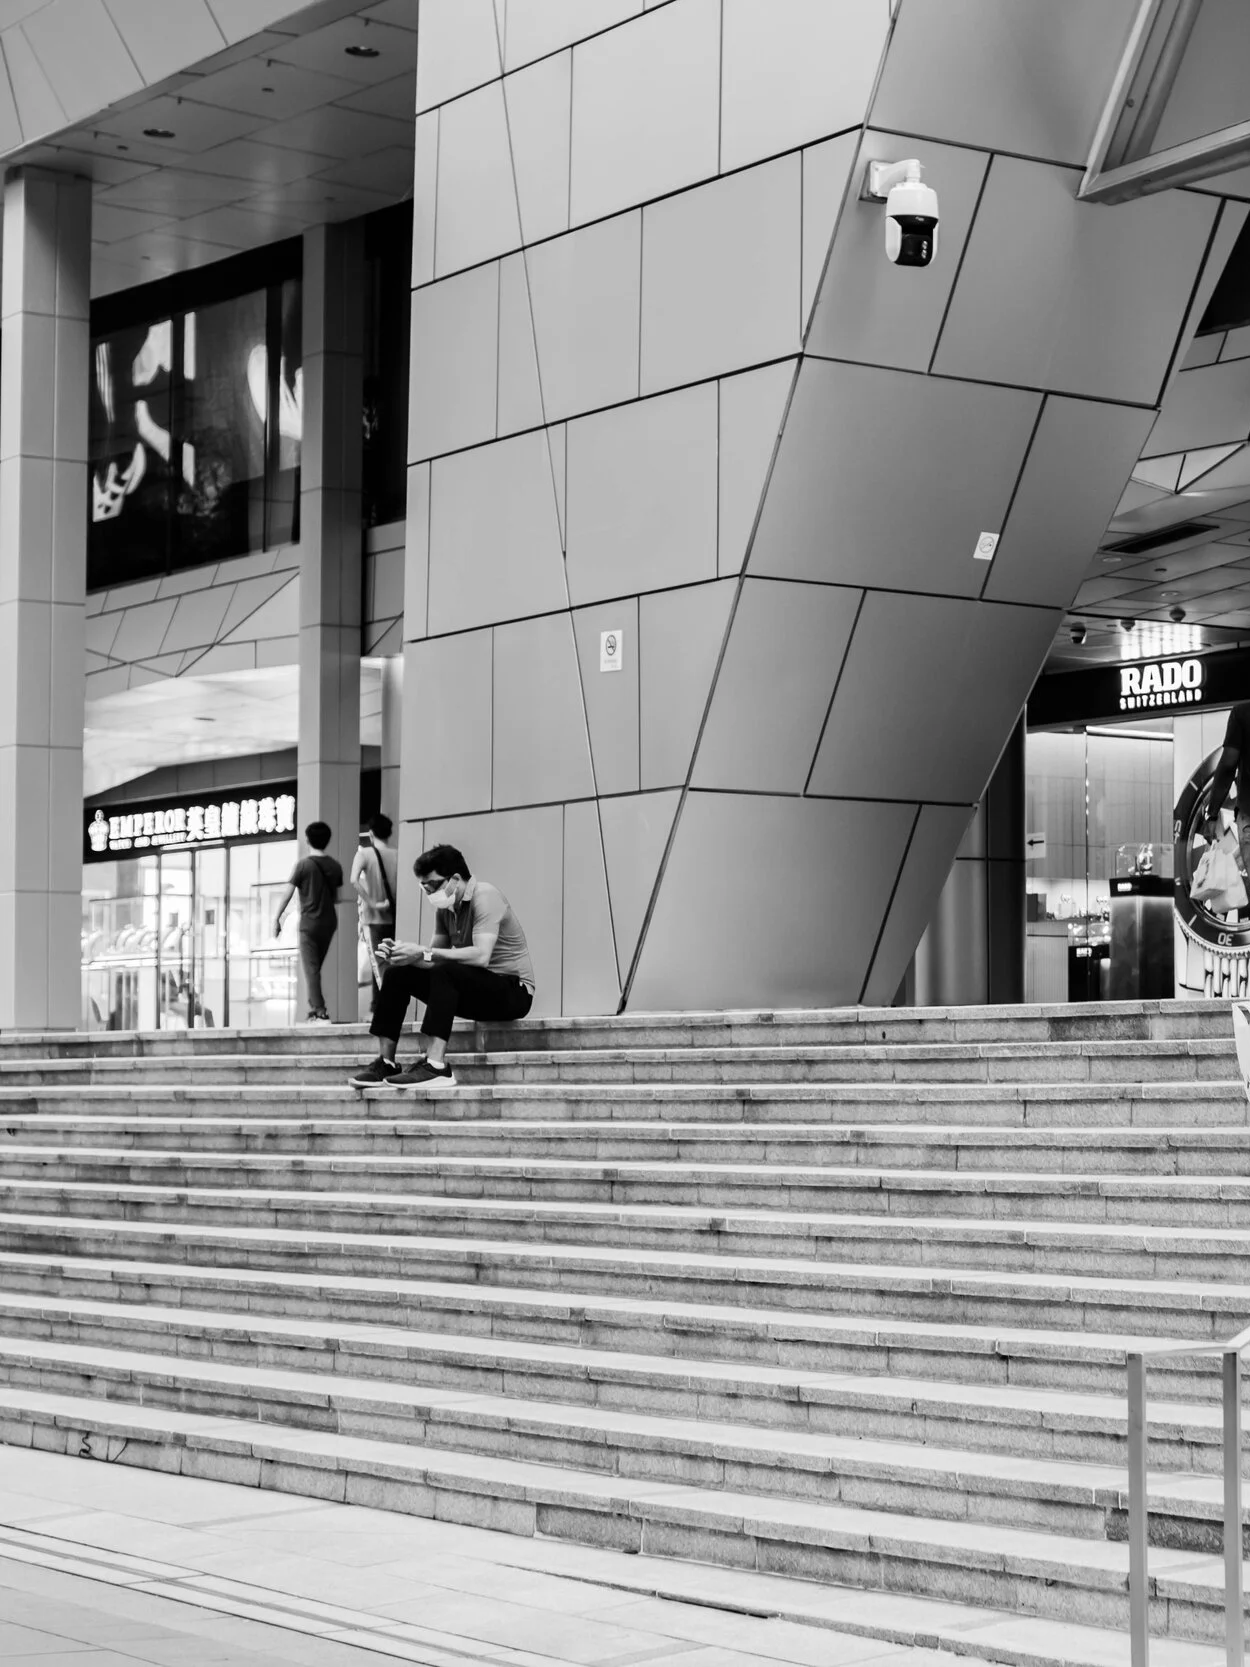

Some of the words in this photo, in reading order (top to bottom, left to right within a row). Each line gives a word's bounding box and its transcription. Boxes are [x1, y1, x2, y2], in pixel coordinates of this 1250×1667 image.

[1120, 659, 1202, 696] RADO
[1120, 688, 1202, 710] SWITZERLAND
[108, 808, 186, 839] EMPEROR
